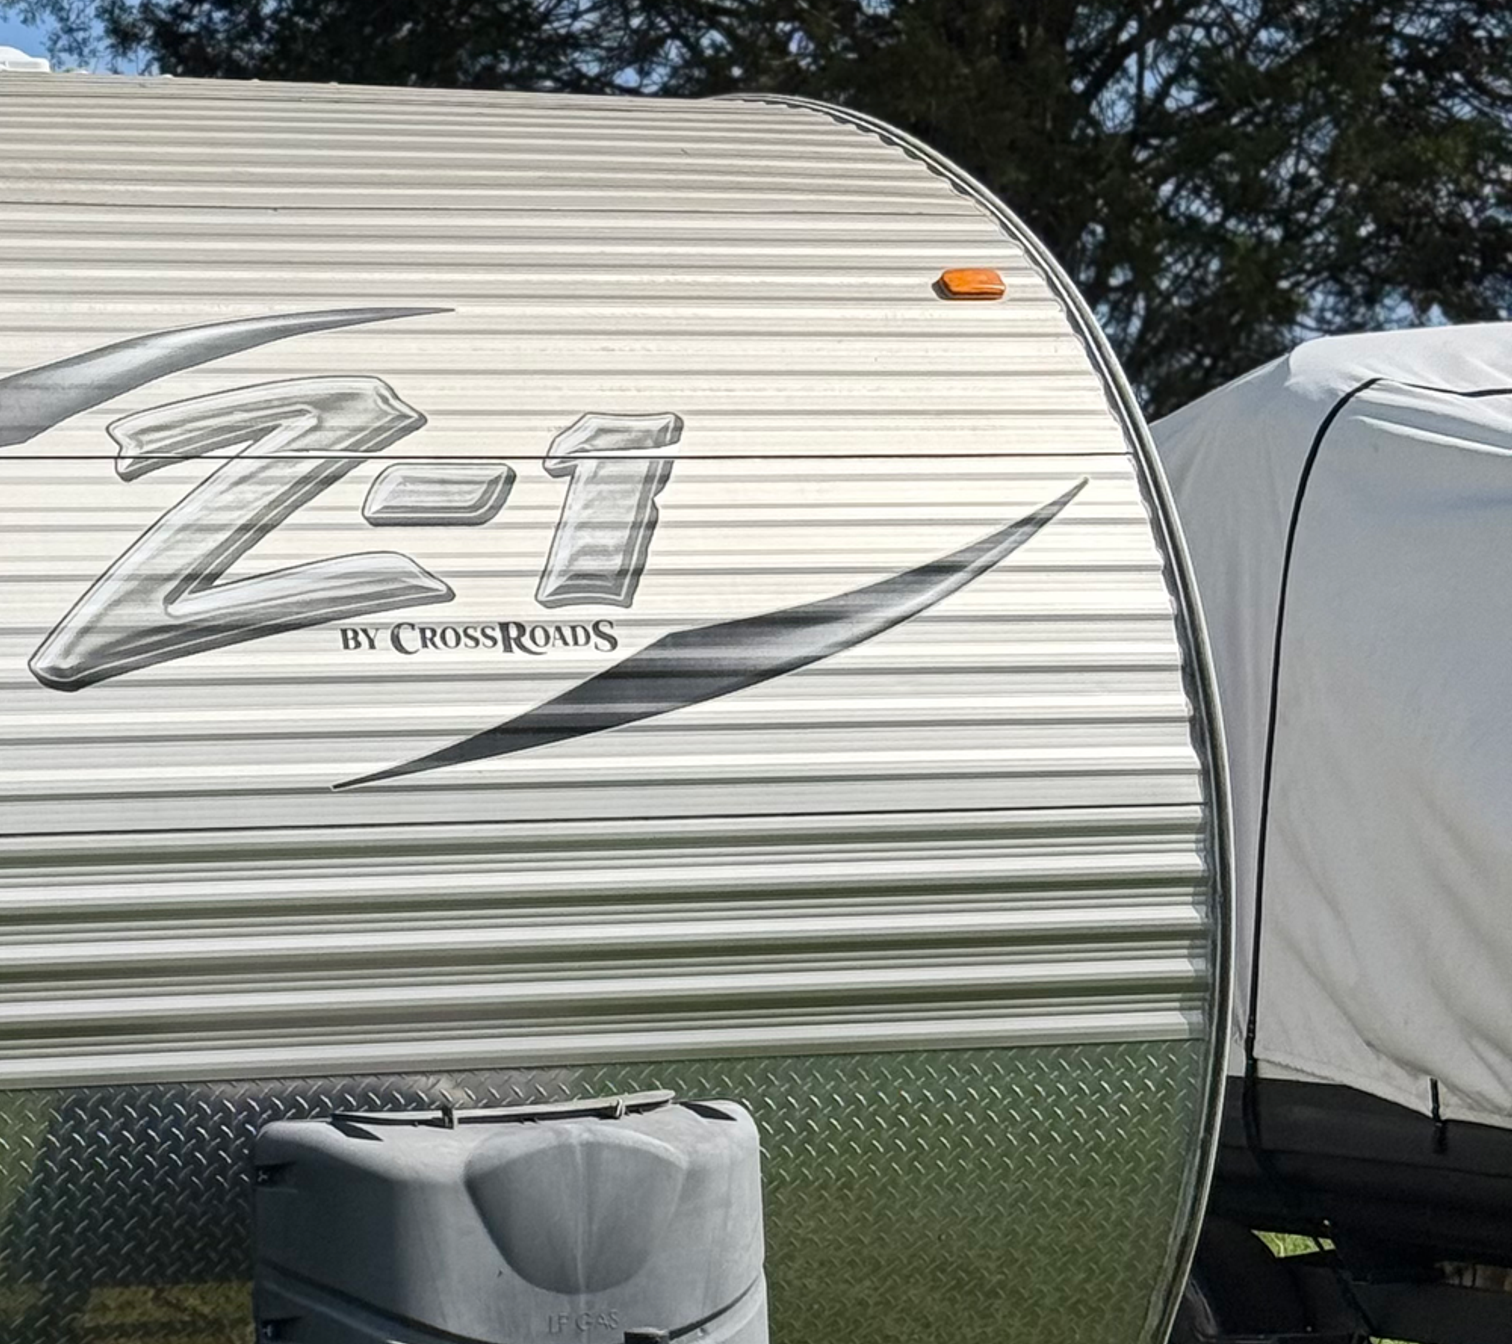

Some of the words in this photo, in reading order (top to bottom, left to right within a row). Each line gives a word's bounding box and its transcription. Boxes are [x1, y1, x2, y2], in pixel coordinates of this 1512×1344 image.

[28, 375, 684, 693] Z-1
[339, 627, 380, 651] BY
[575, 1309, 619, 1333] GAS
